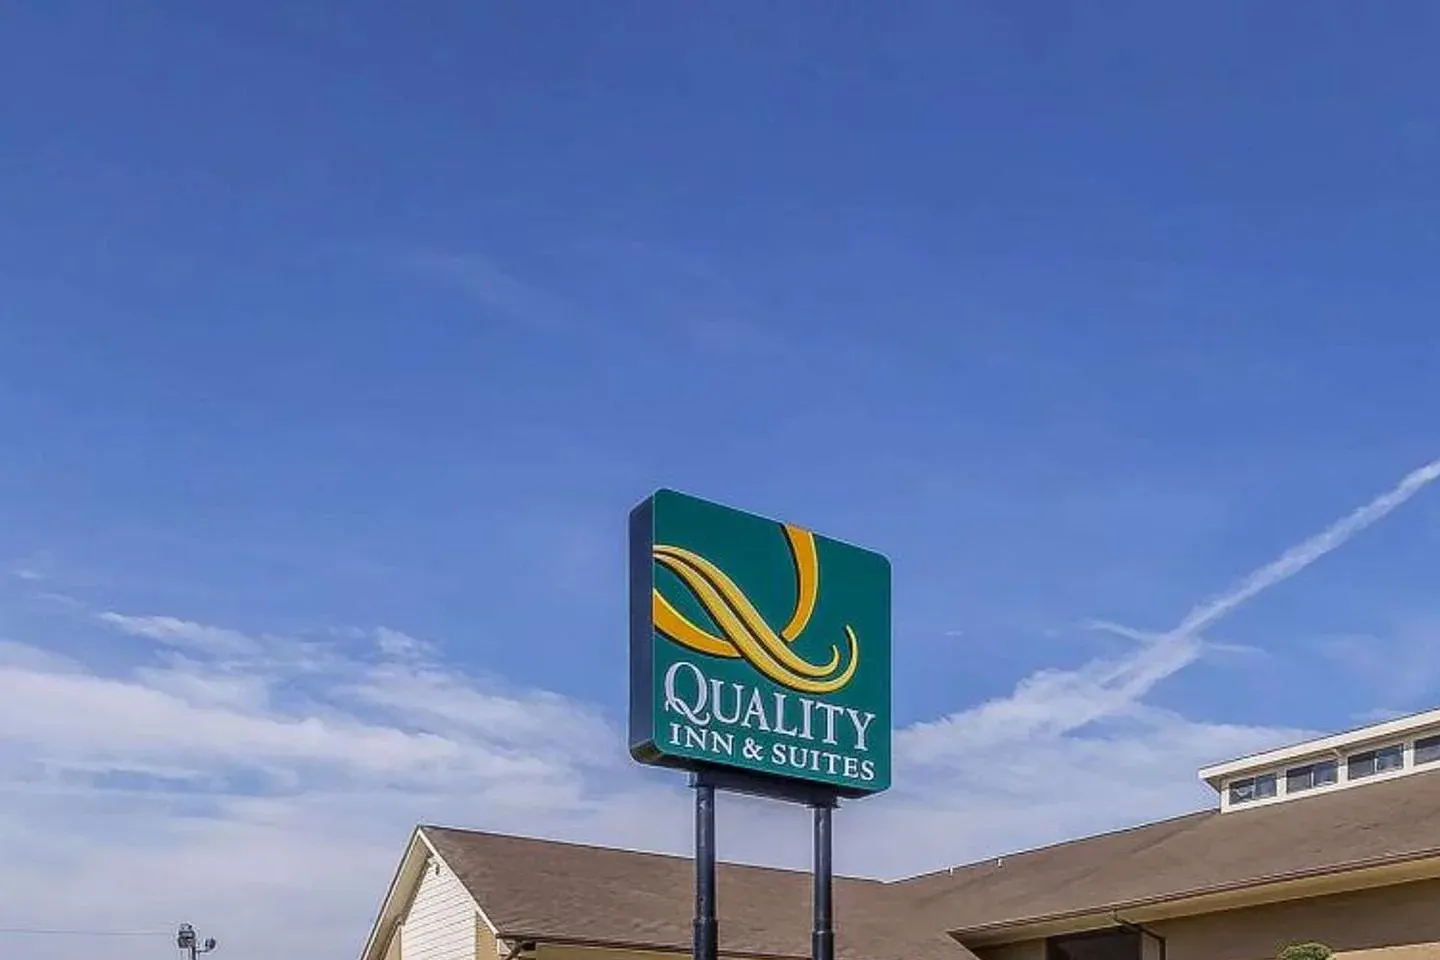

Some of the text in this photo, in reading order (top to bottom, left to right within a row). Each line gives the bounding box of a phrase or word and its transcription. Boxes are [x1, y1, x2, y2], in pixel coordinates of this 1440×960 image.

[664, 661, 875, 751] QUALITY
[669, 722, 875, 781] INN & SUITES
